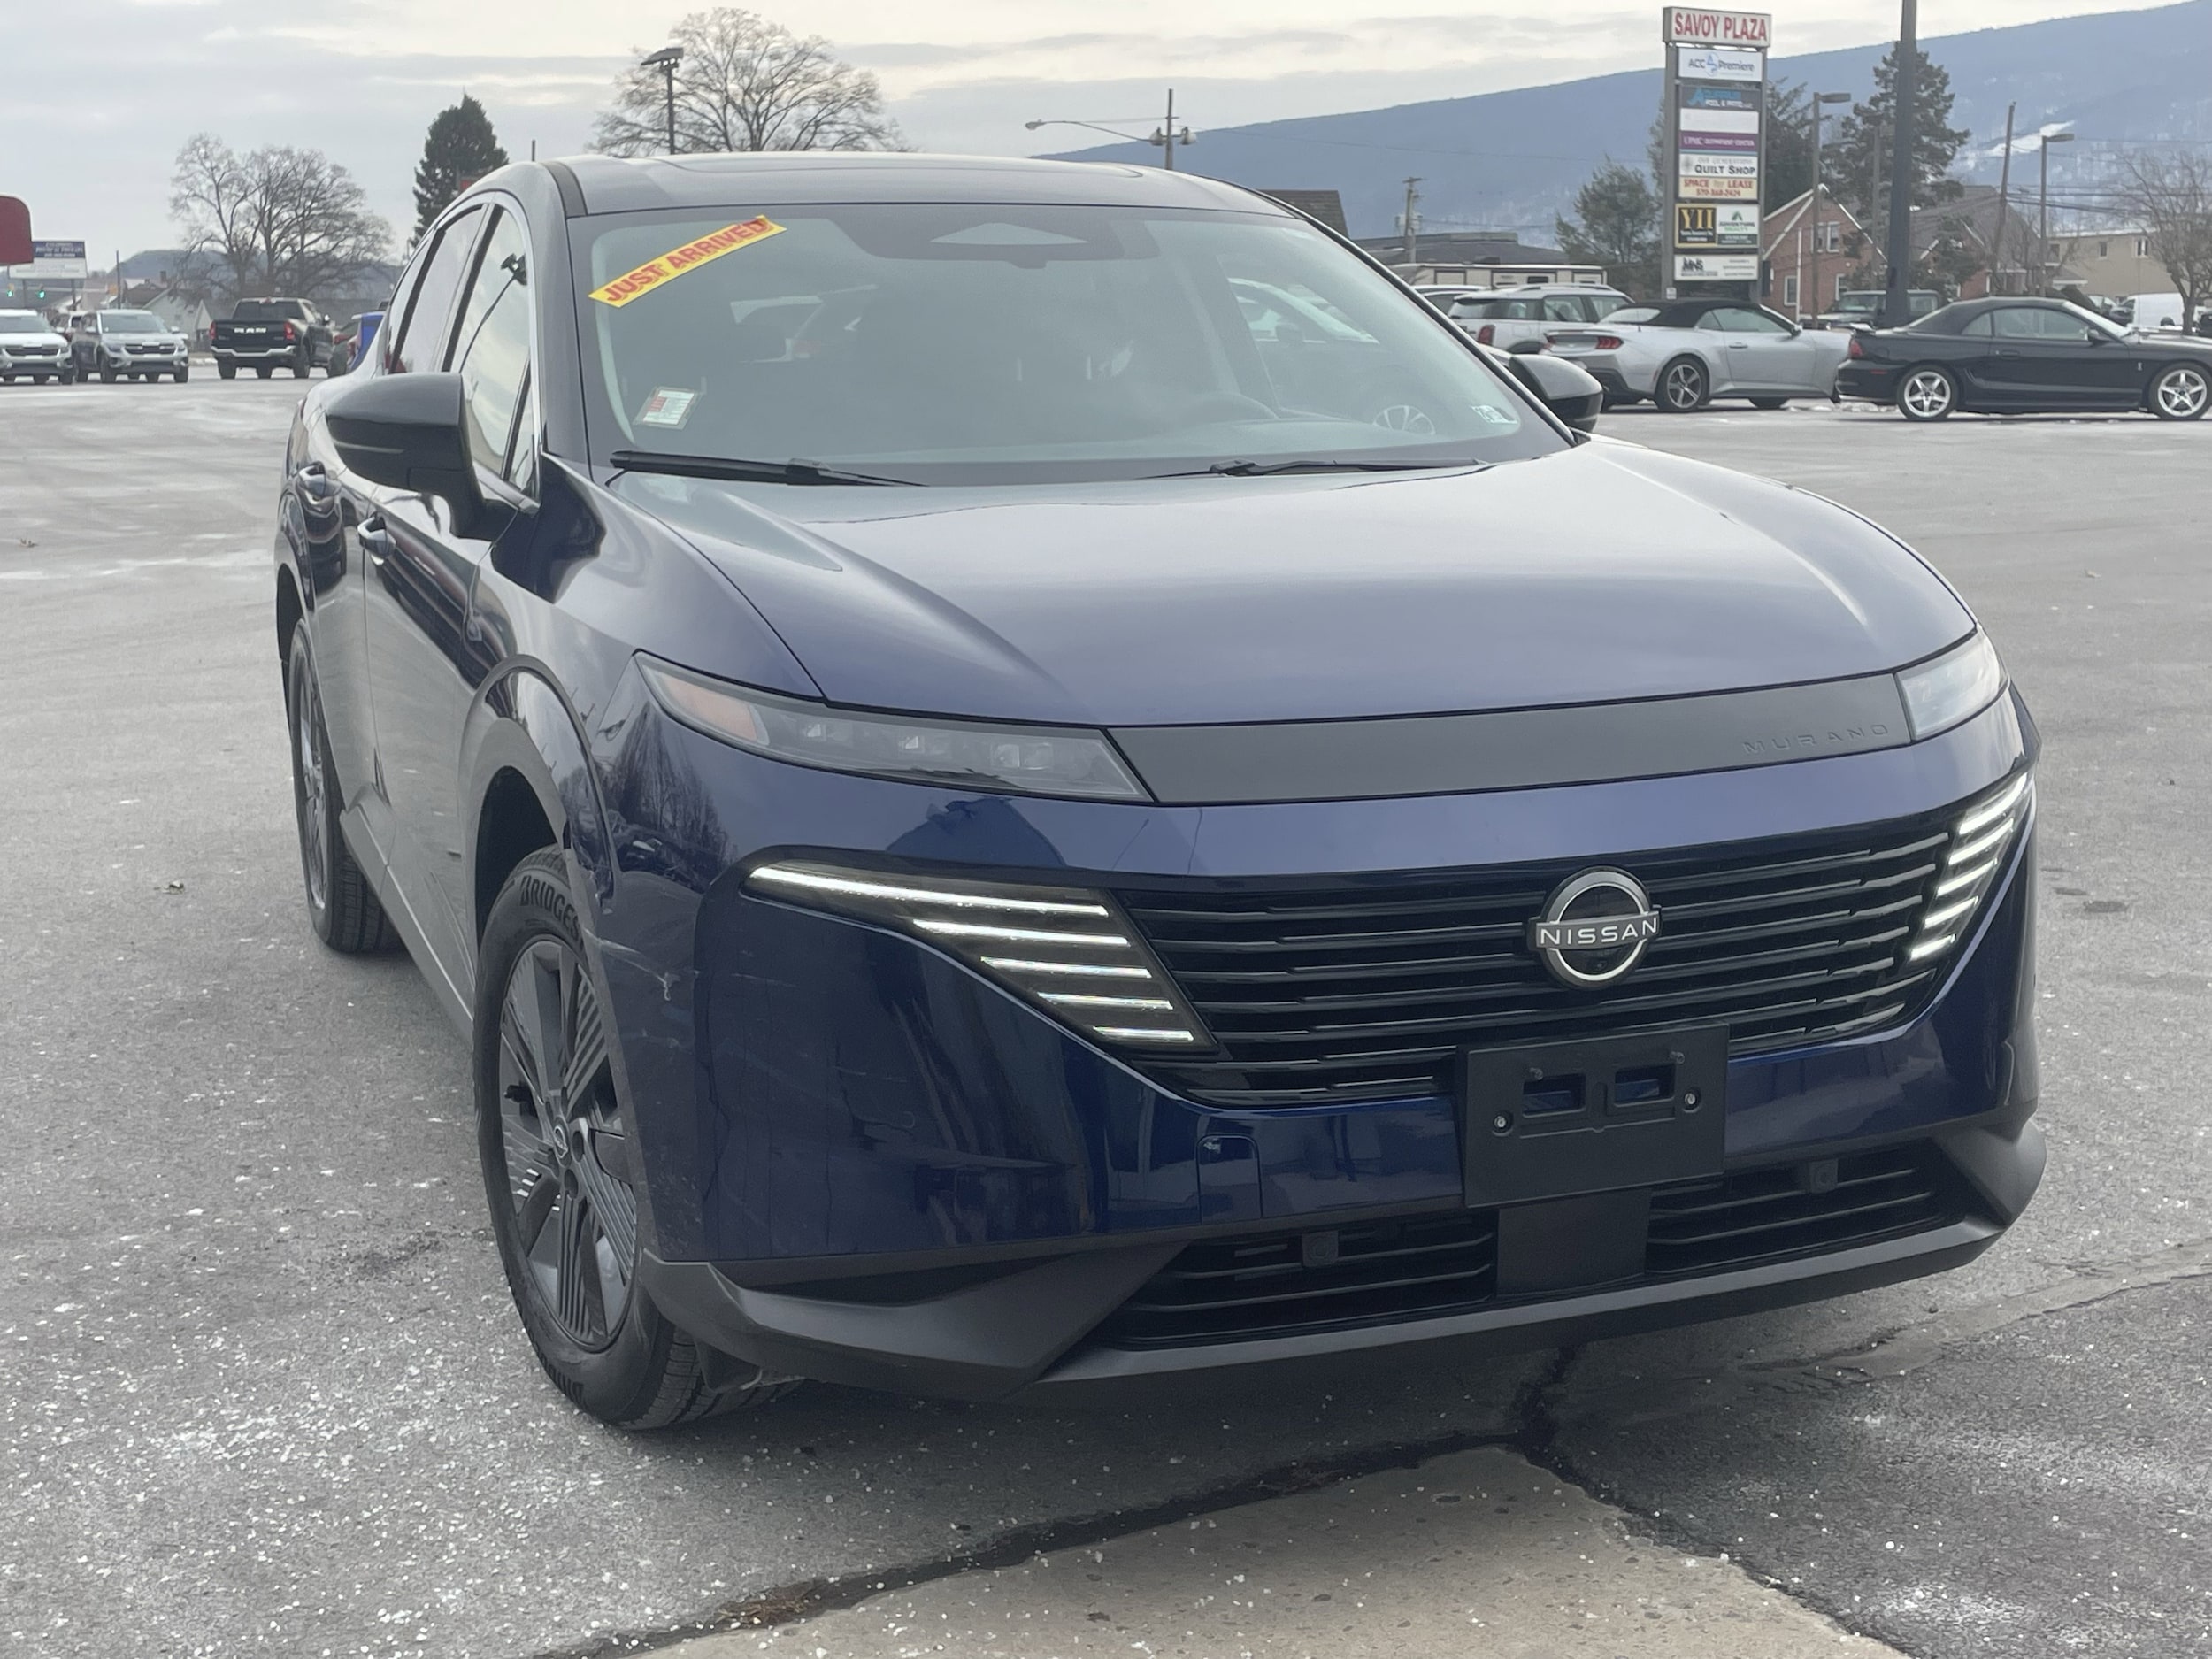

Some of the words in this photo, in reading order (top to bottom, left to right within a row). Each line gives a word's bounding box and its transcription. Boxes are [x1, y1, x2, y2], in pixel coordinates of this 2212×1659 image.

[1675, 12, 1719, 38] SAVOY
[1724, 16, 1767, 42] PLAZA
[1688, 58, 1706, 69] ACC
[1718, 58, 1755, 72] Premiere
[1684, 179, 1709, 188] SPACE
[1727, 180, 1753, 189] LEASE
[1694, 164, 1724, 174] QUILT
[1728, 165, 1756, 175] SHOP
[604, 264, 666, 303] JUST
[664, 218, 772, 271] ARRIVED
[1743, 724, 1888, 754] MURANO
[1540, 917, 1657, 946] NISSAN
